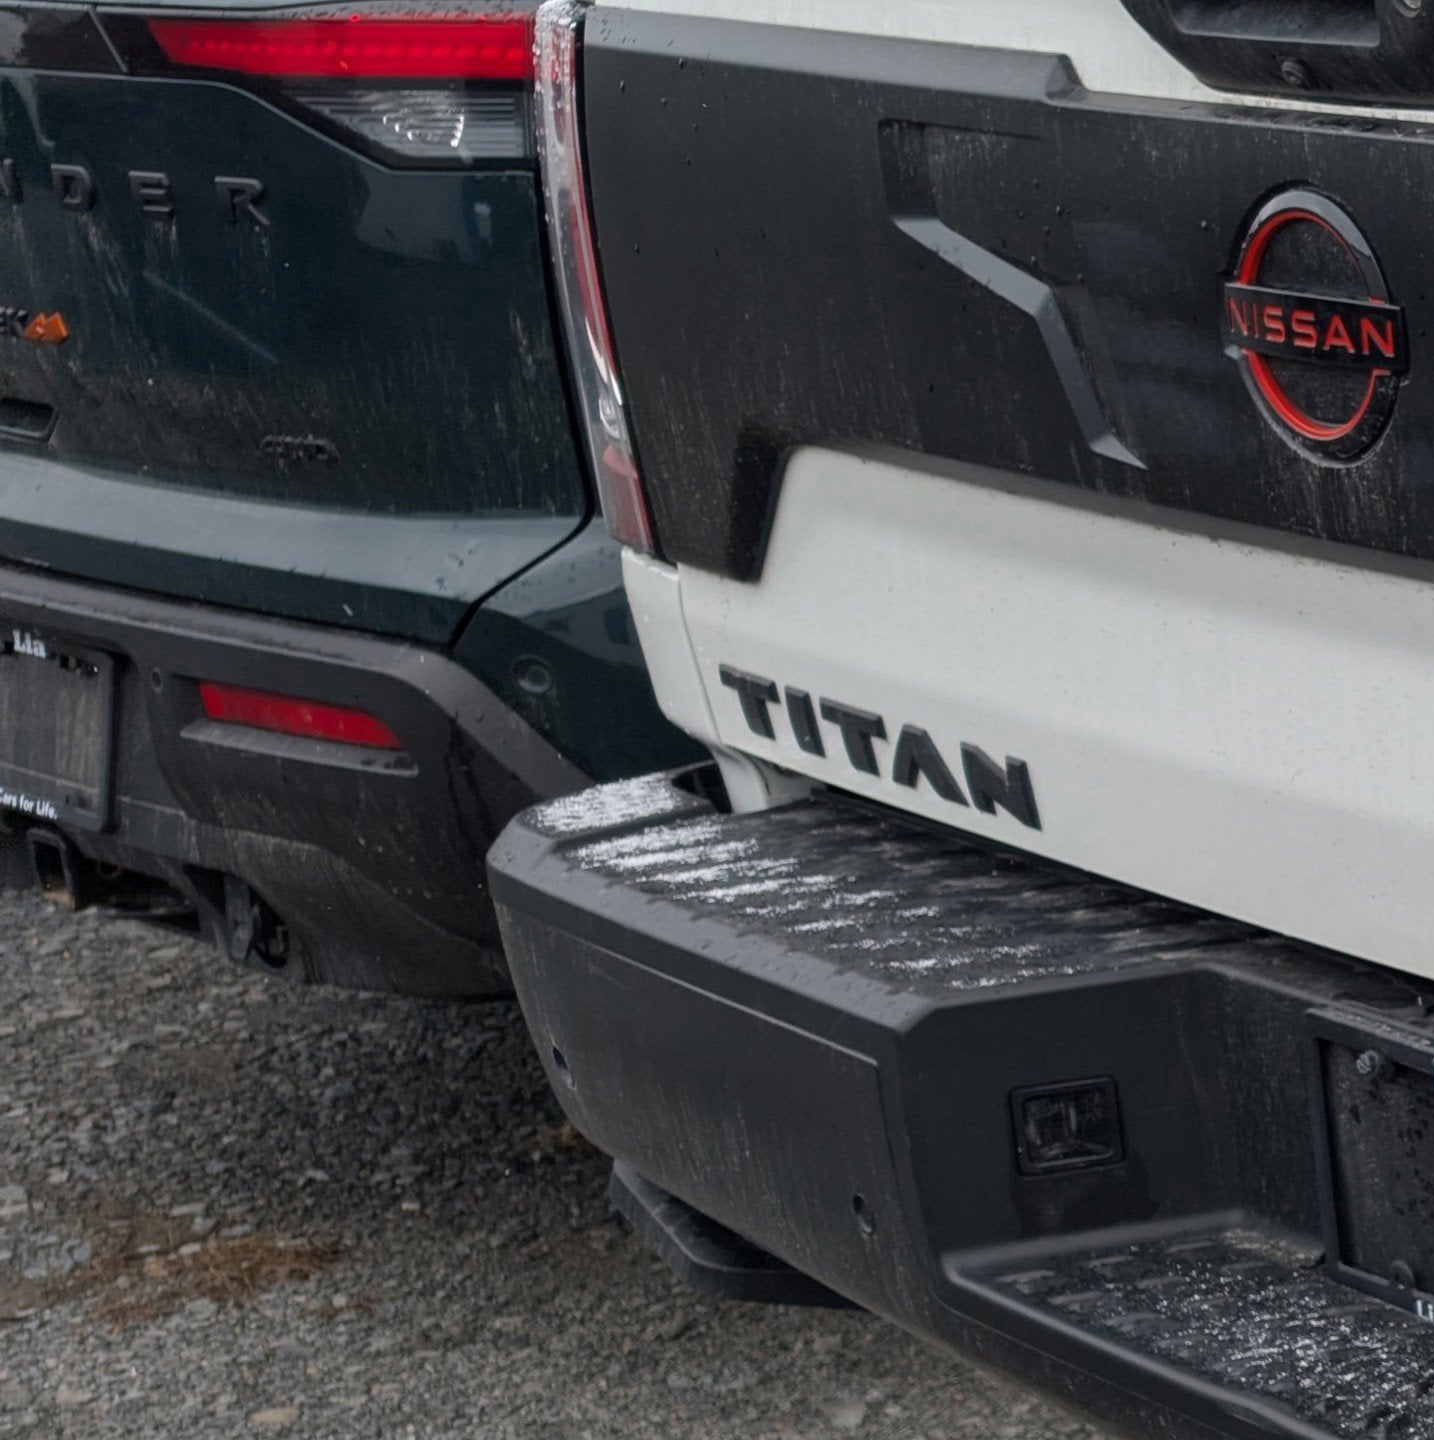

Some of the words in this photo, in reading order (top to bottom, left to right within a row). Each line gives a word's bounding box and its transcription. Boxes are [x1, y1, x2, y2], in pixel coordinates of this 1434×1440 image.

[1227, 296, 1395, 358] NISSAN
[13, 628, 46, 659] Lia
[719, 662, 1042, 832] TITAN
